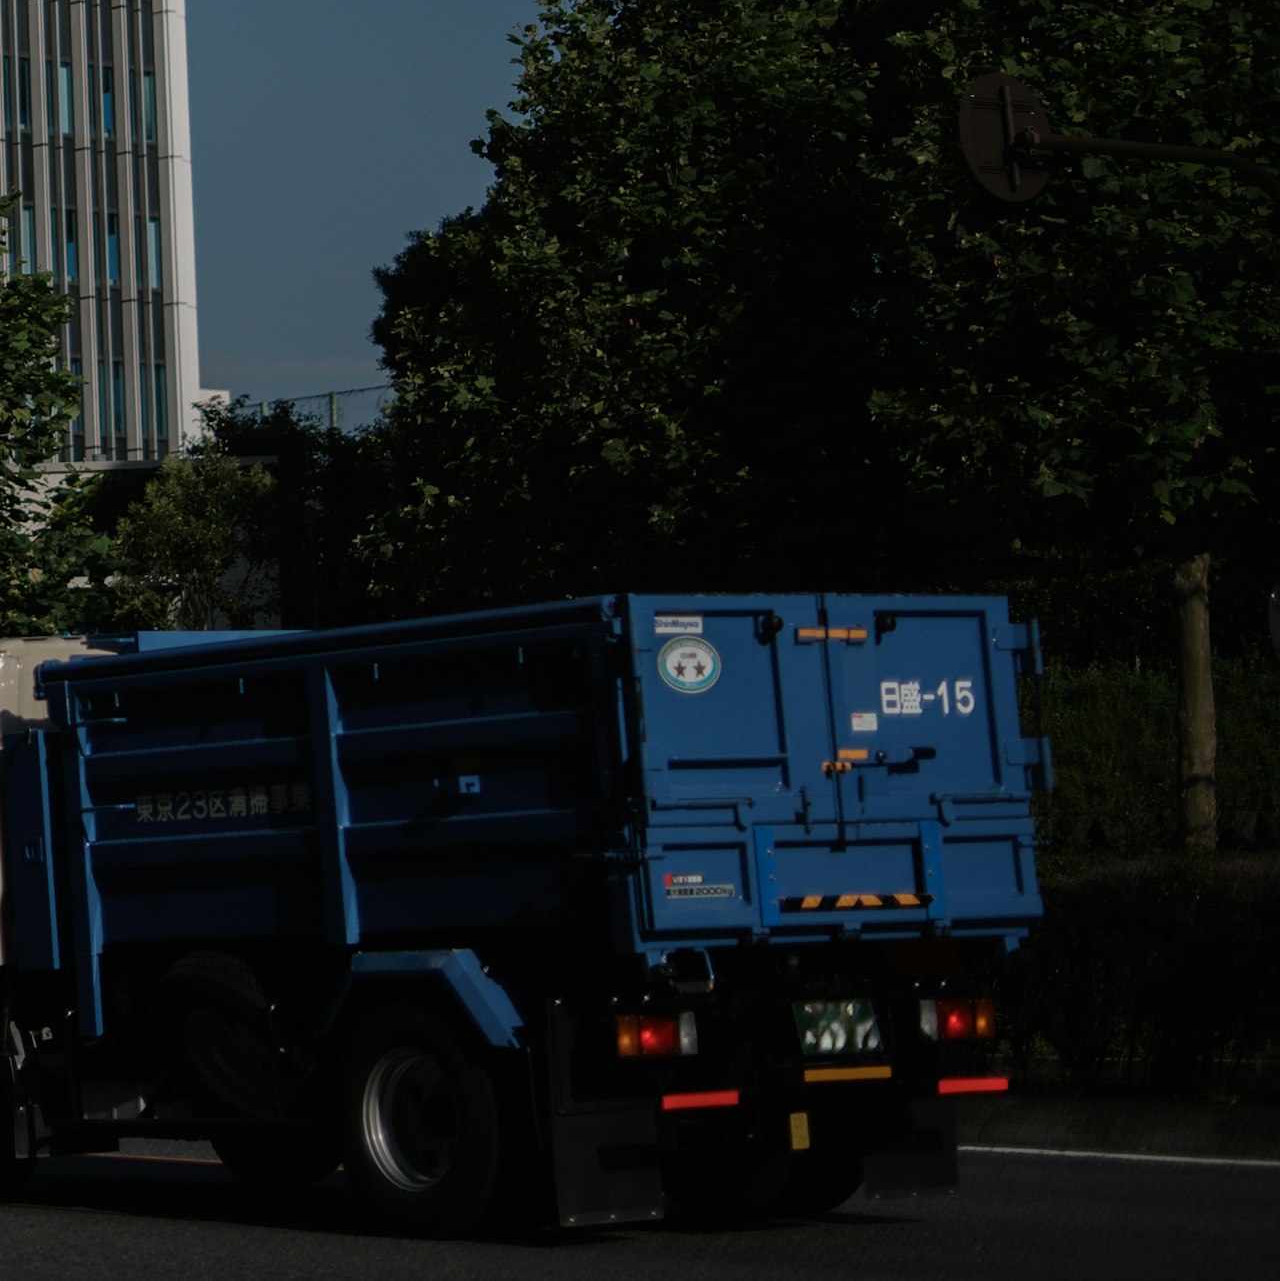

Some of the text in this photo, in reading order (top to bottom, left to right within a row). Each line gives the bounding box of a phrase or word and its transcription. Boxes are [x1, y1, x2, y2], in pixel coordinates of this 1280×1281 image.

[654, 619, 700, 629] ShinMaywa
[881, 680, 975, 714] 日盛-15
[136, 781, 312, 824] 東京23区清掃事業
